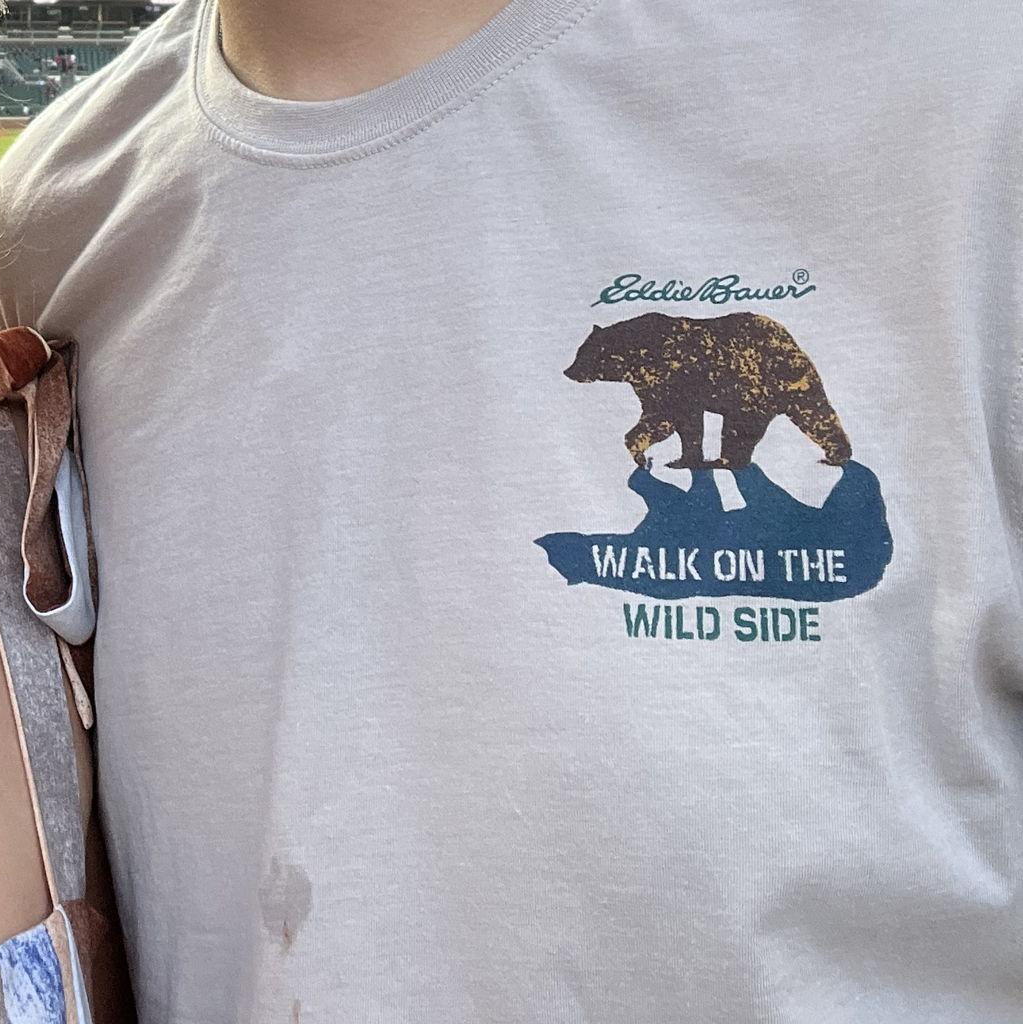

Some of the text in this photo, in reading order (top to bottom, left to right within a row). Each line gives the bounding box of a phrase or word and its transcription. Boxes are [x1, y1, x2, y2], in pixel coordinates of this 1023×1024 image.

[591, 273, 697, 307] Eddie
[591, 543, 847, 584] WALK ON THE
[622, 603, 822, 642] WILD SIDE
